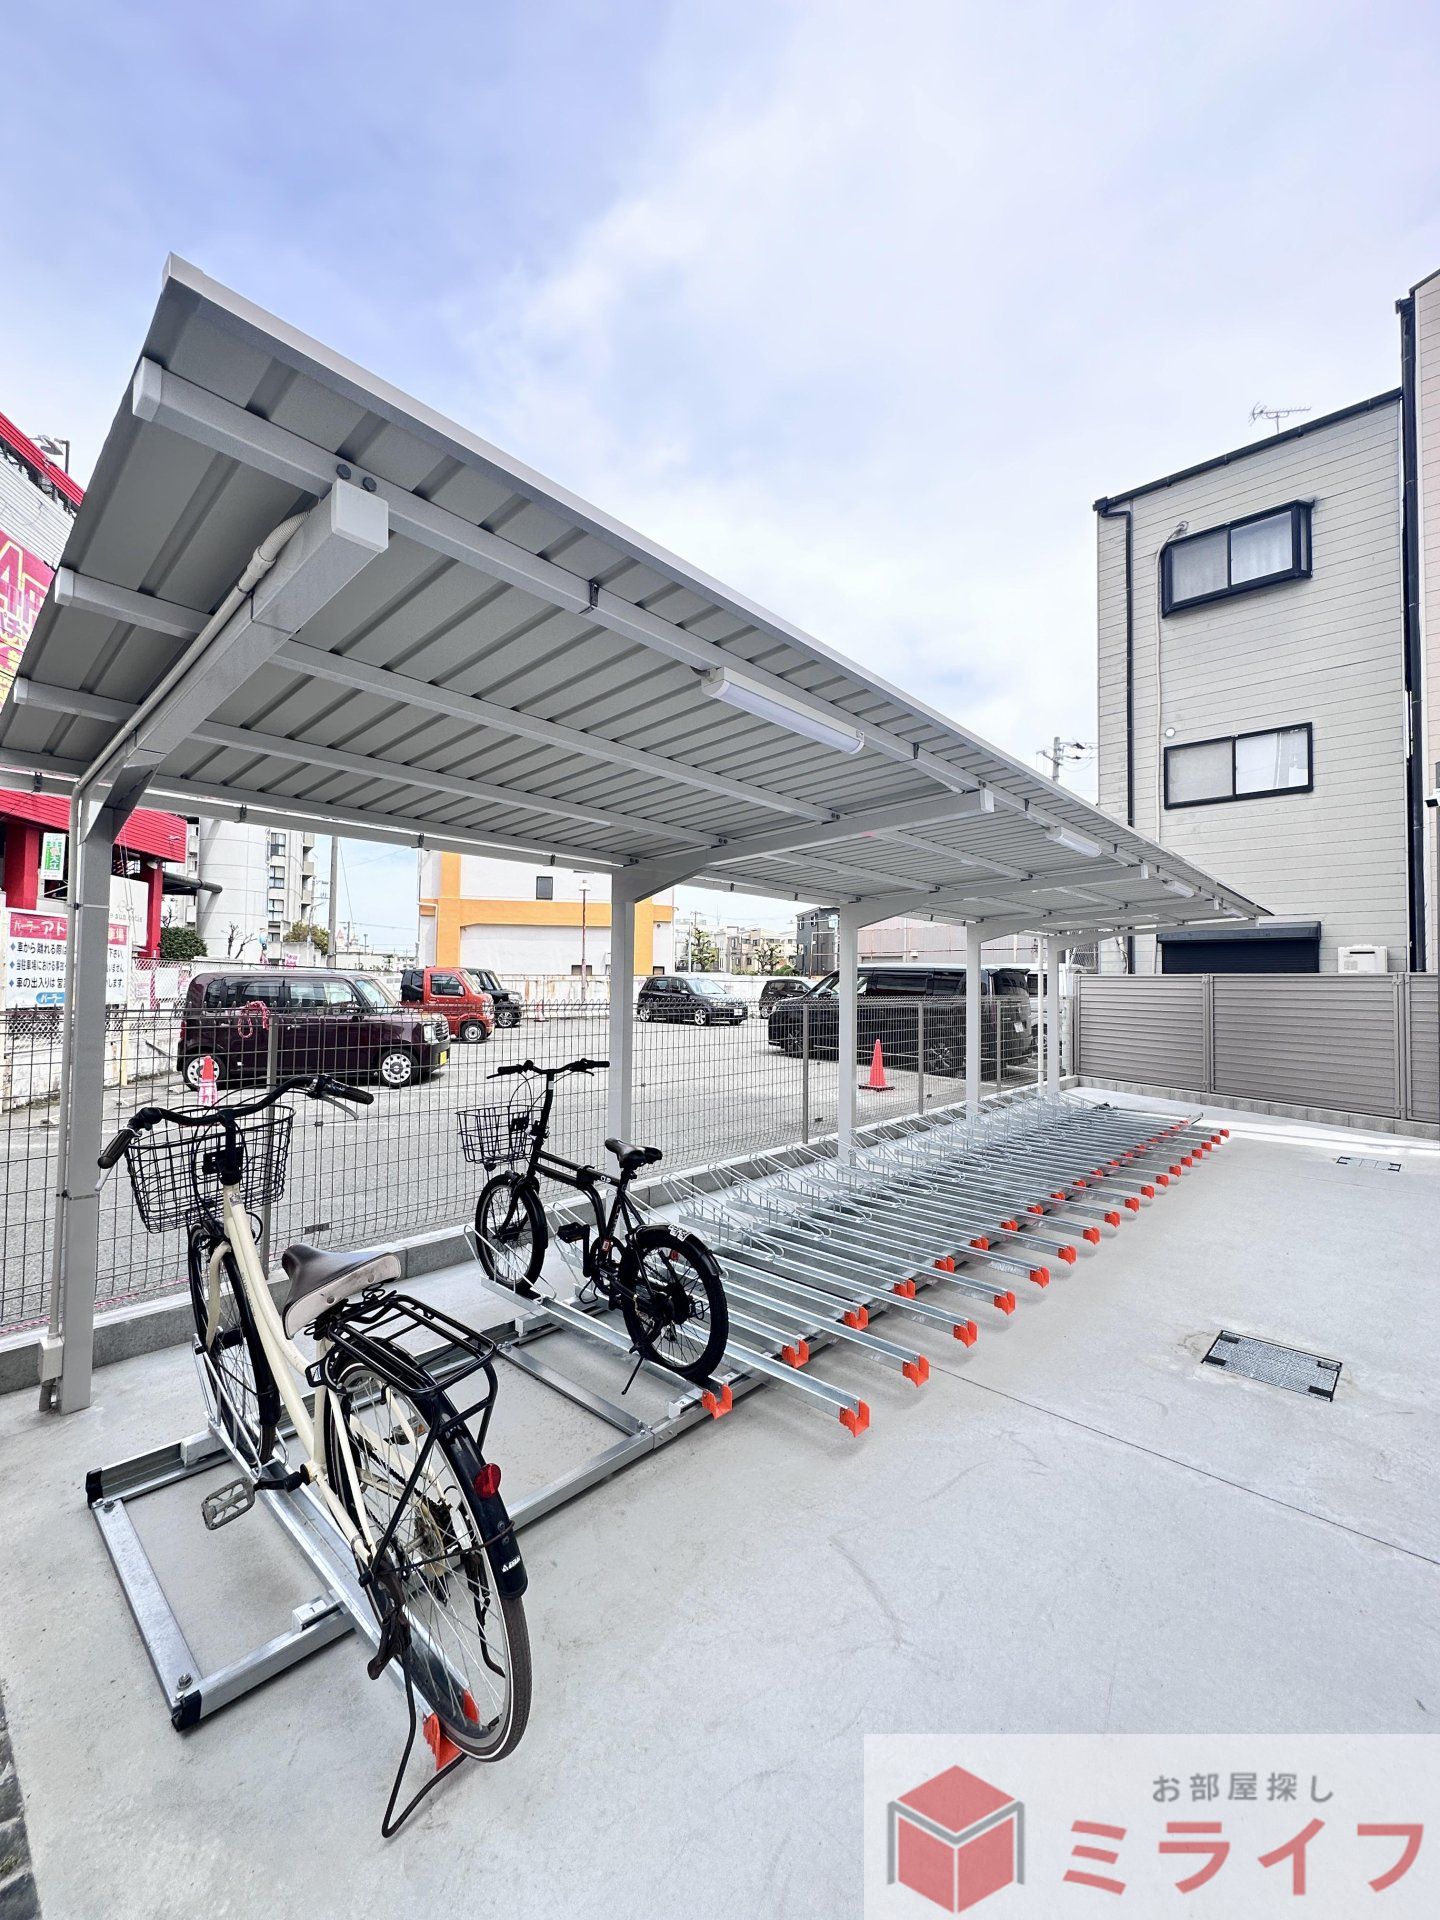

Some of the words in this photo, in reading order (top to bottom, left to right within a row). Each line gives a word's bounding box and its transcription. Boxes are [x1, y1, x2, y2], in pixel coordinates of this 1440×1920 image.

[16, 959, 67, 971] 当駐車場における事故
[16, 977, 66, 988] 車の出入りは営
